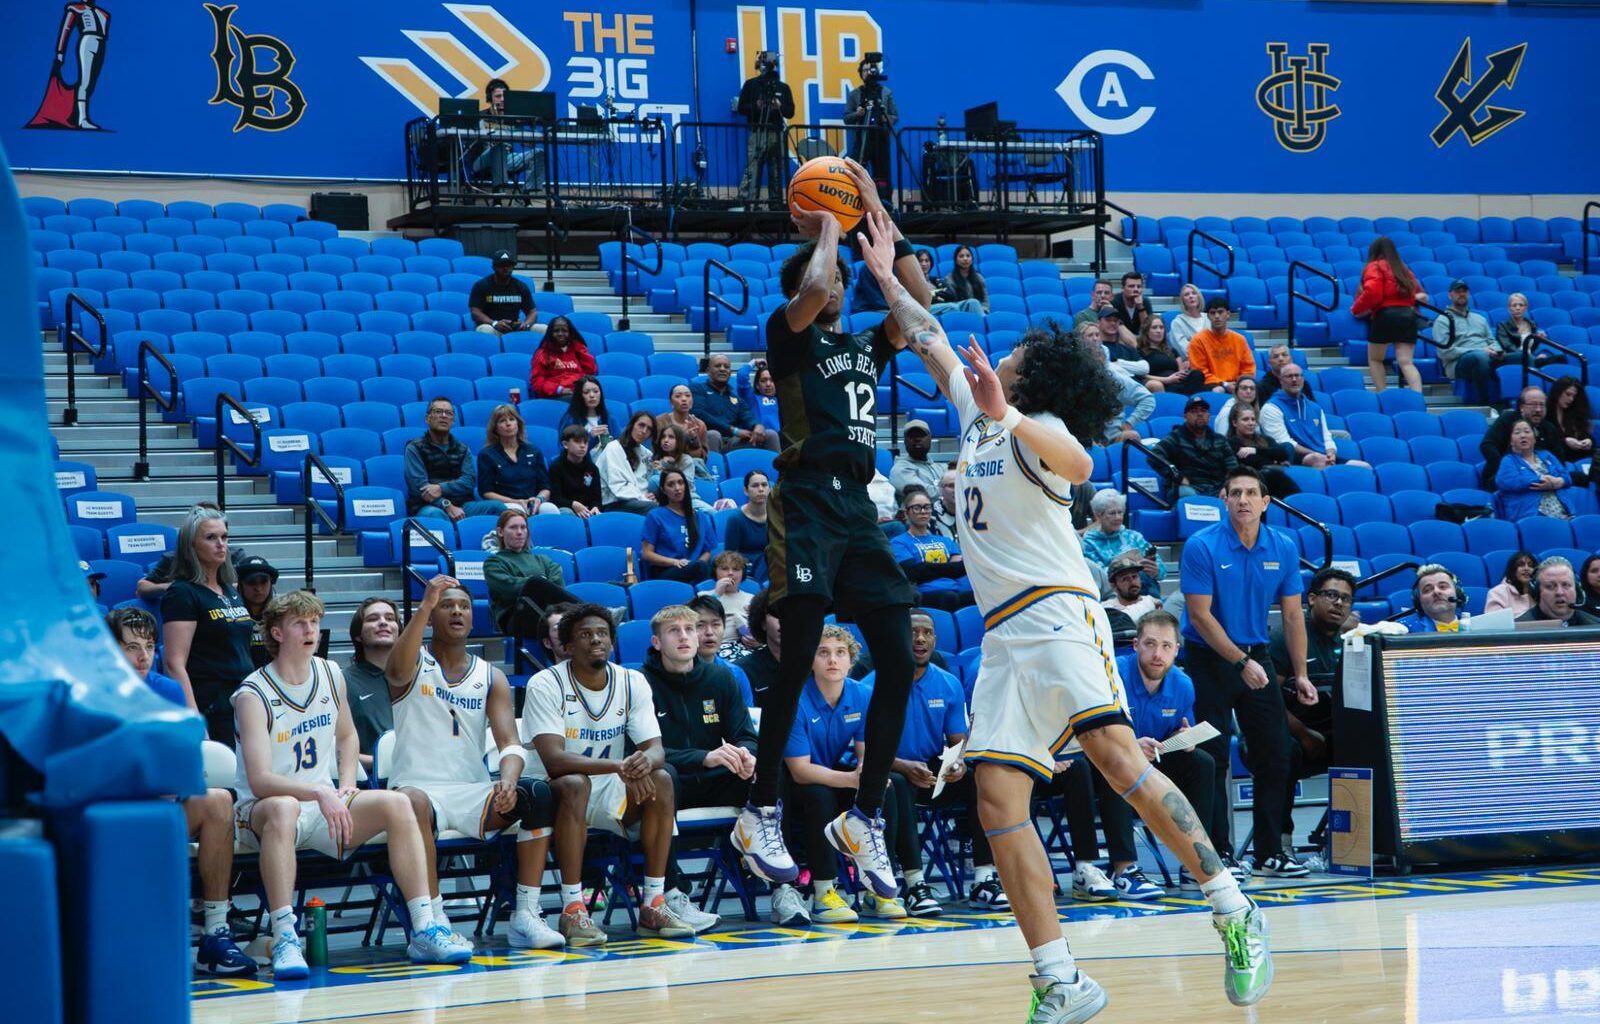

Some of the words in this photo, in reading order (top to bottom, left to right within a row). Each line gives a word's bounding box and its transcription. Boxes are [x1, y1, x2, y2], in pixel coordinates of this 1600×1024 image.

[563, 11, 655, 54] THE
[566, 56, 648, 99] BIG
[816, 352, 852, 379] LONG
[844, 381, 875, 425] 12
[848, 425, 876, 449] STATE
[292, 735, 318, 774] 13
